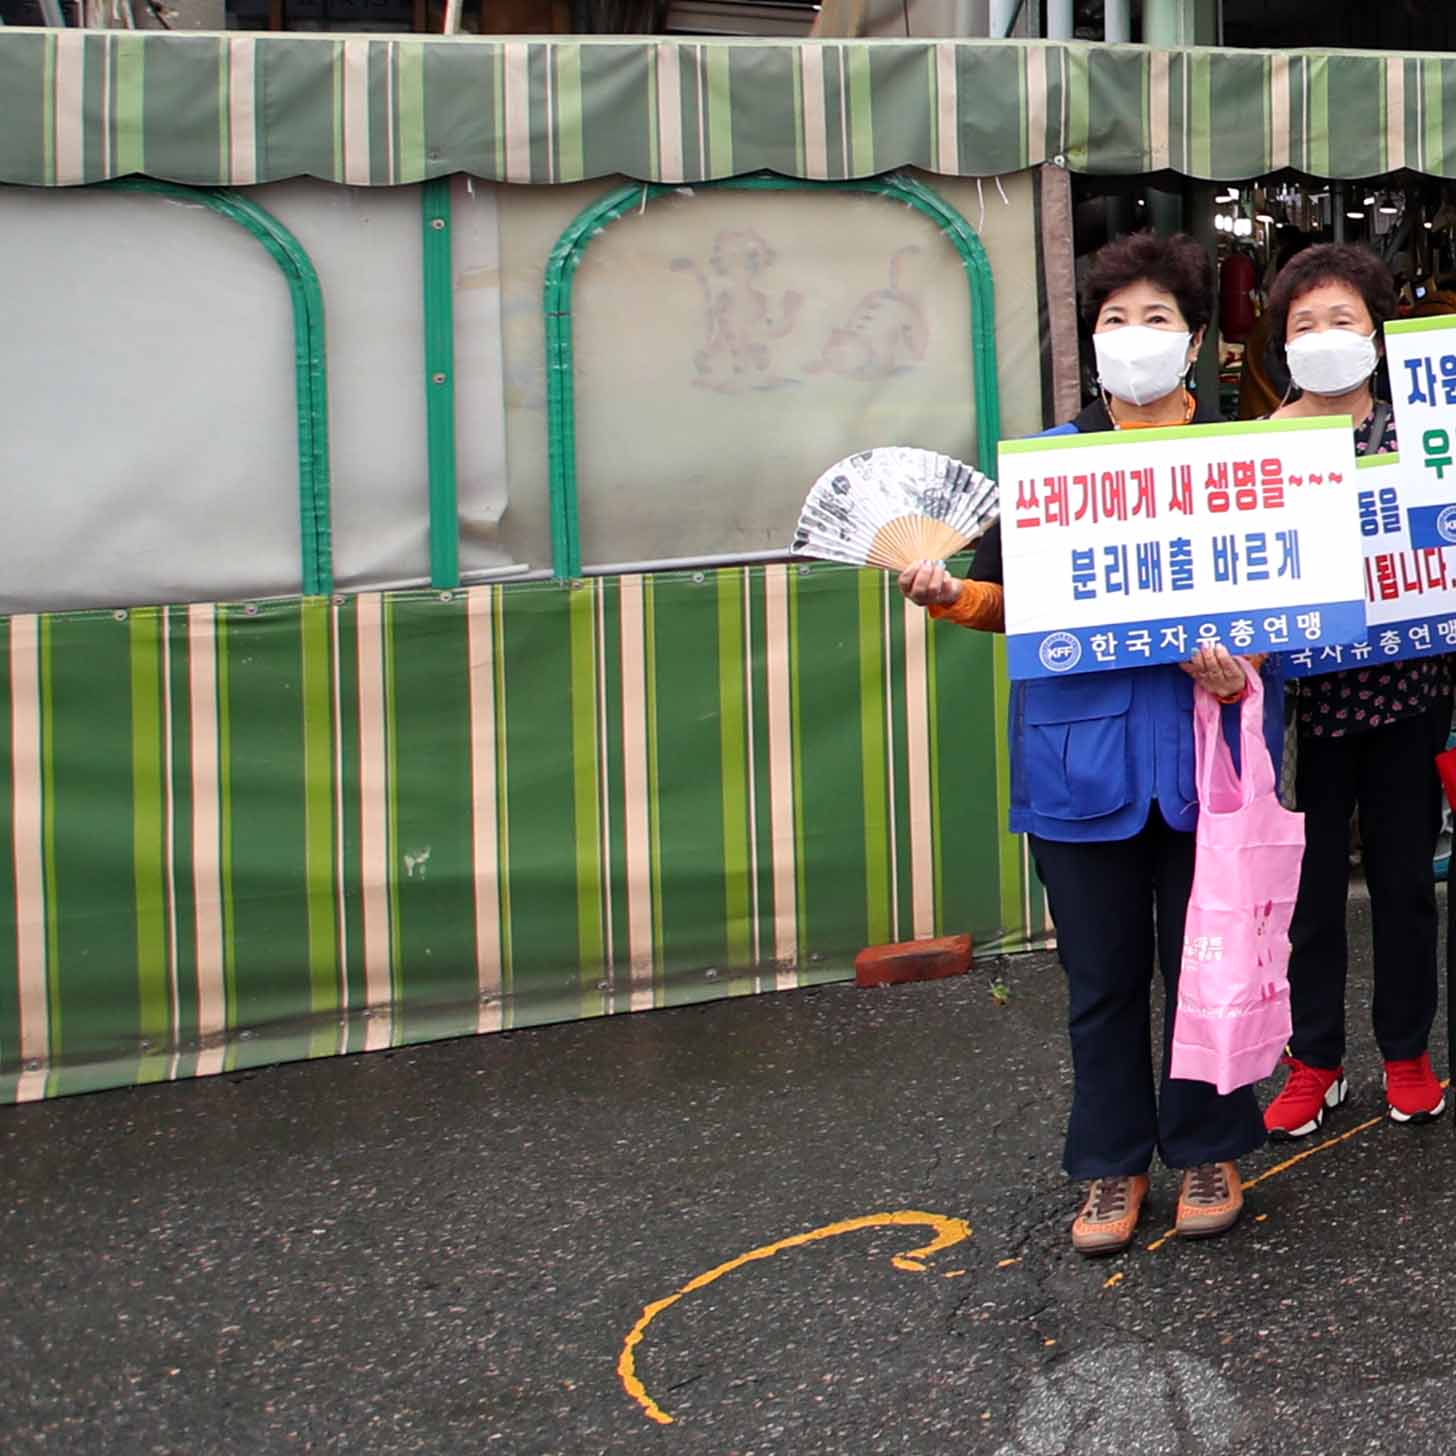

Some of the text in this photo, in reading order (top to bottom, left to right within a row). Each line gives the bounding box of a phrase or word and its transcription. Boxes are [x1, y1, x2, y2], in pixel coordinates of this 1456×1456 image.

[1015, 466, 1157, 529] 쓰레기에게
[1168, 462, 1195, 517] 새
[1071, 528, 1302, 601] 분리배출 바르게
[1089, 610, 1323, 663] 한국자유총연맹
